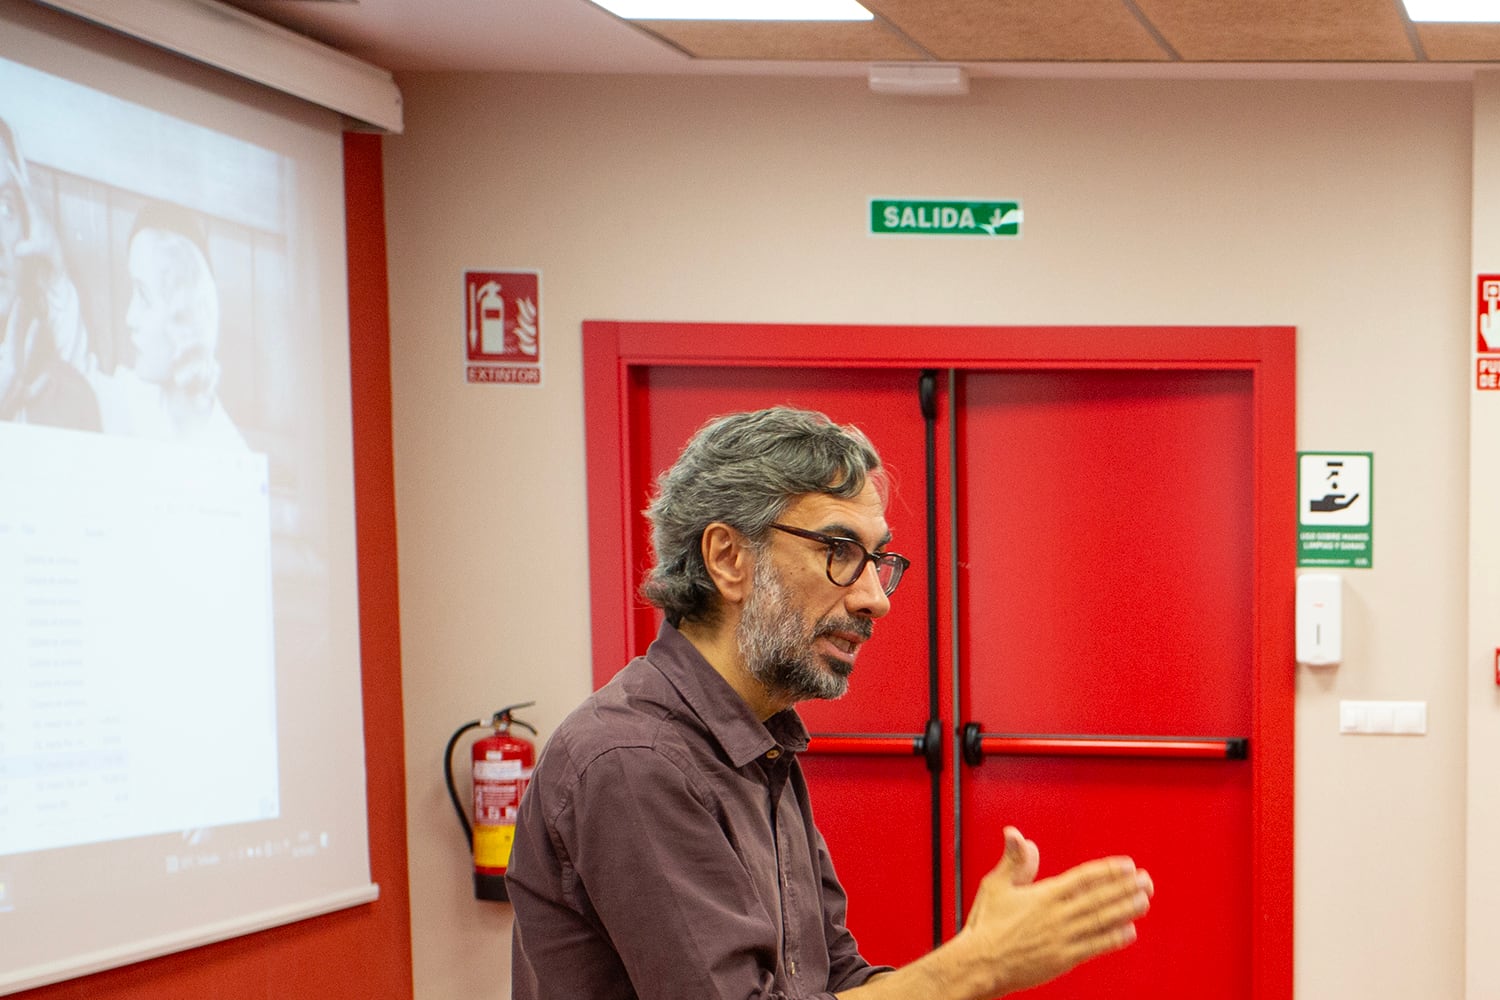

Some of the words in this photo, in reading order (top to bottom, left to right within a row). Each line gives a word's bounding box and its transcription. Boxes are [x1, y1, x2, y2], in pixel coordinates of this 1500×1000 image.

[883, 206, 976, 229] SALIDA
[468, 367, 539, 383] EXTINTOR
[1479, 374, 1497, 387] DE
